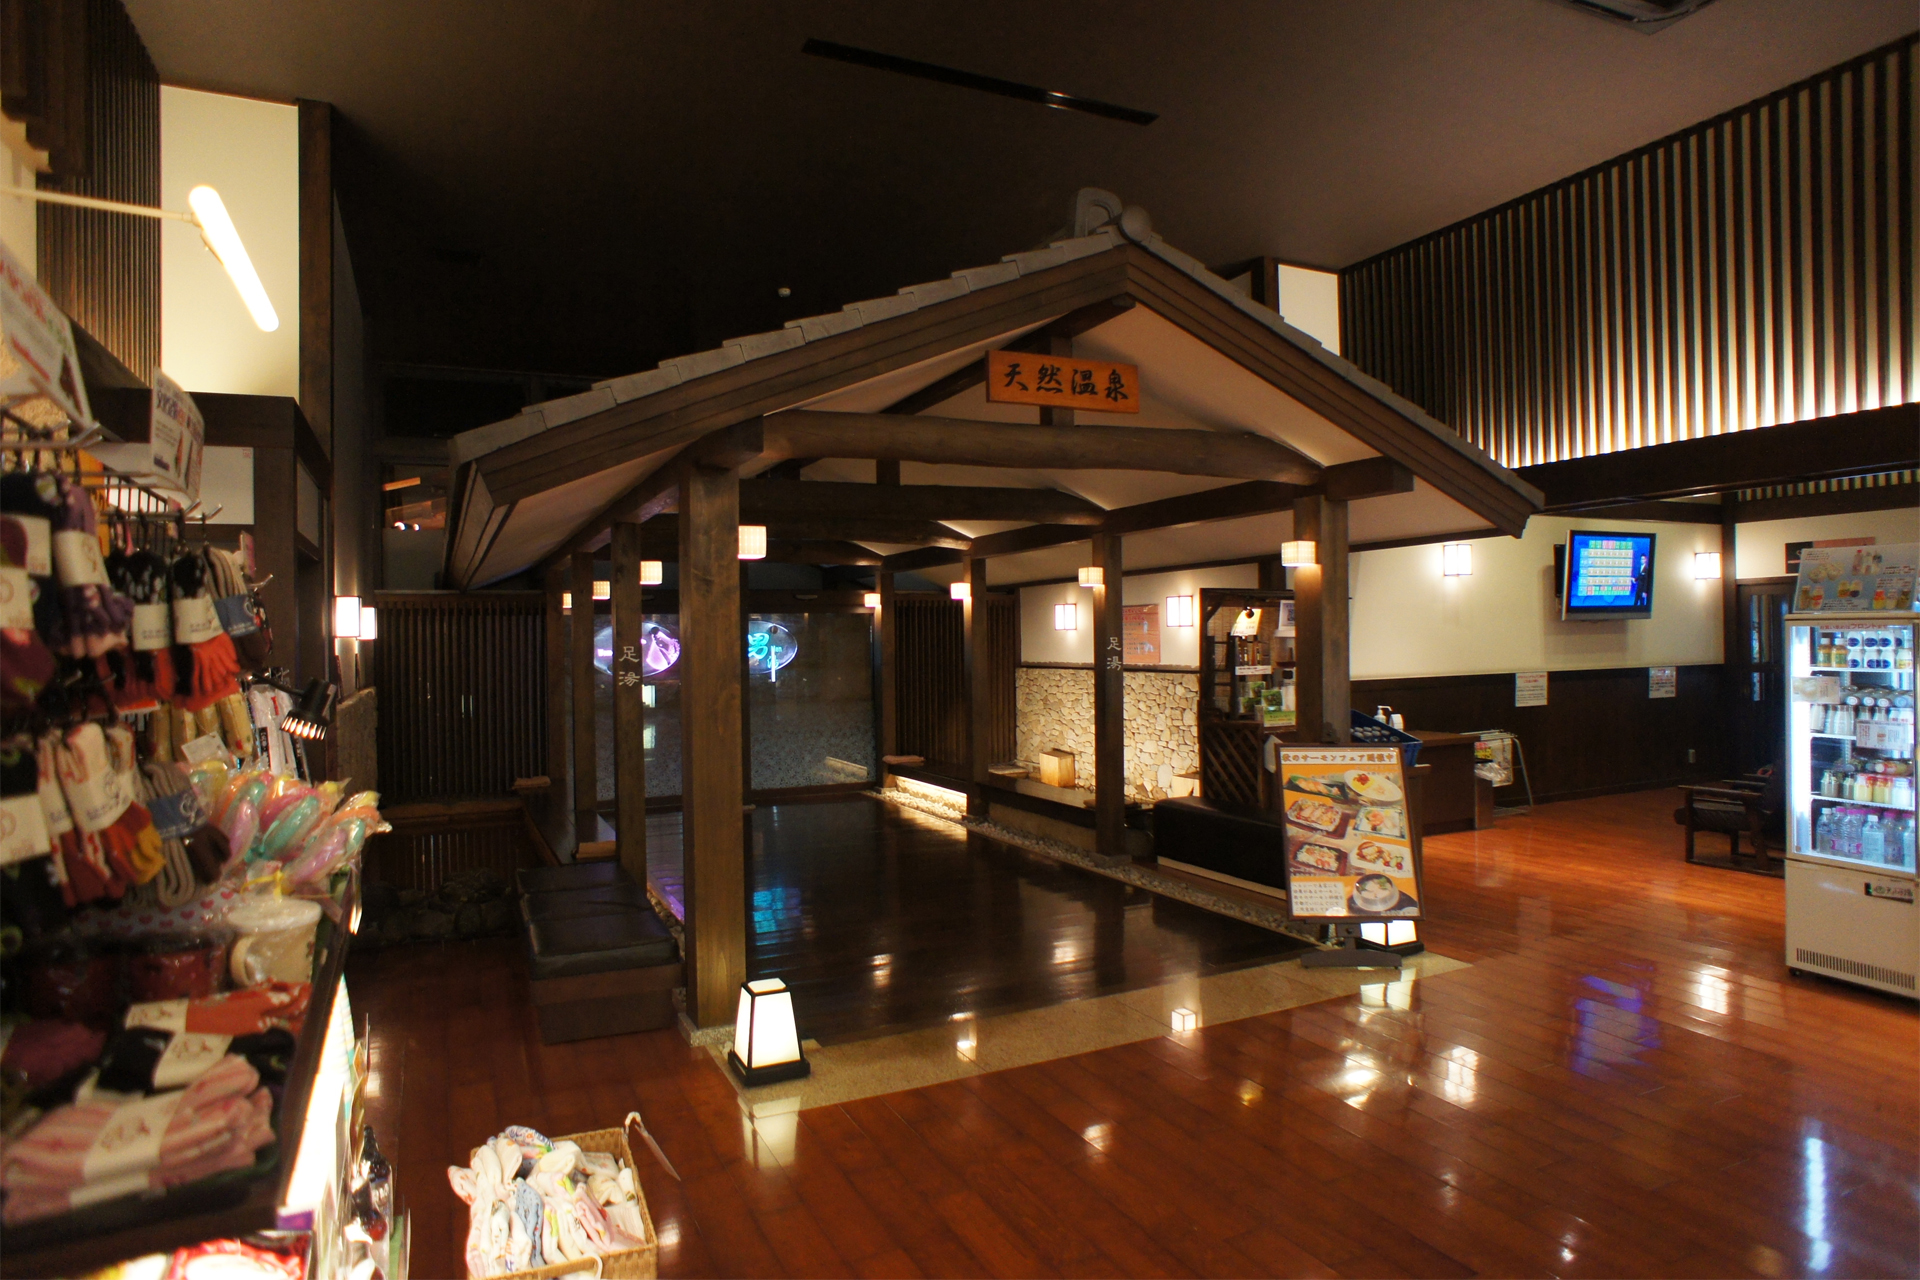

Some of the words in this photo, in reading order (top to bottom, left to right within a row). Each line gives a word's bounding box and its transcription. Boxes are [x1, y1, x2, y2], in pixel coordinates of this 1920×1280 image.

[1004, 363, 1129, 402] 天然温泉
[618, 645, 641, 687] 足湯
[1107, 636, 1122, 671] 足湯
